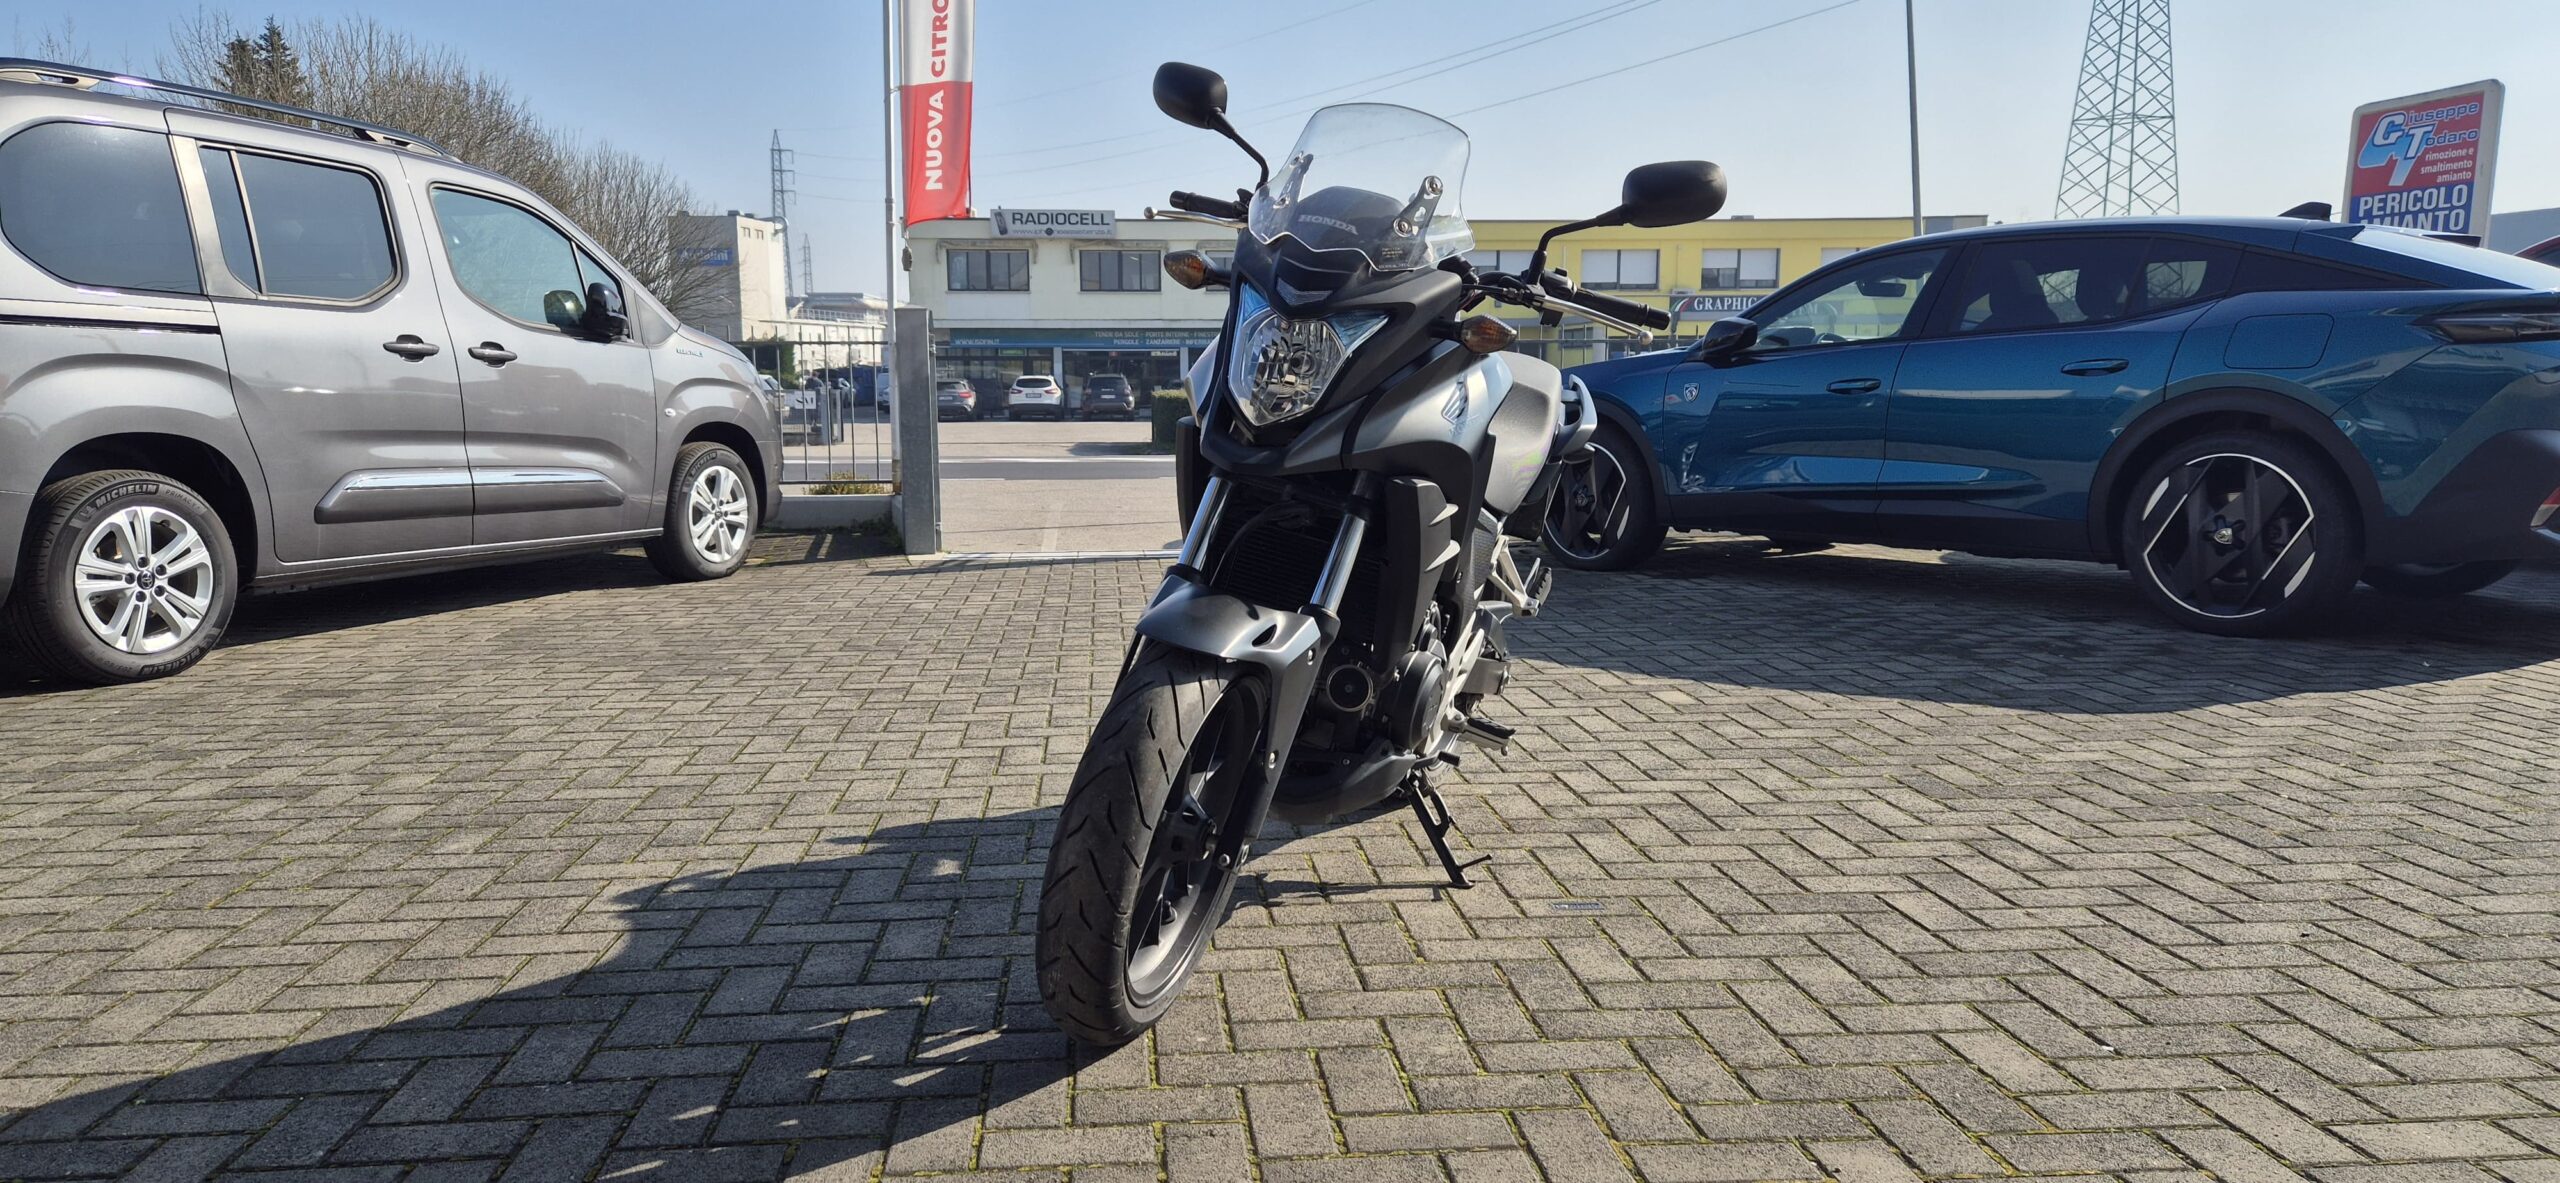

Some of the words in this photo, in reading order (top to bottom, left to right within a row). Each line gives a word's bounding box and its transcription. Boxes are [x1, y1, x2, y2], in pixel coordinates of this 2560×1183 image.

[931, 0, 949, 78] CITRO
[925, 89, 944, 190] NUOVA
[2425, 150, 2468, 161] rimozione
[2420, 160, 2473, 175] smaltimento
[2436, 171, 2472, 183] amianto
[2358, 184, 2468, 217] PERICOLO
[1011, 212, 1110, 226] RADIOCELL
[1298, 214, 1359, 235] HONDA
[2360, 209, 2466, 231] IANTO
[95, 483, 157, 507] MICHELIN
